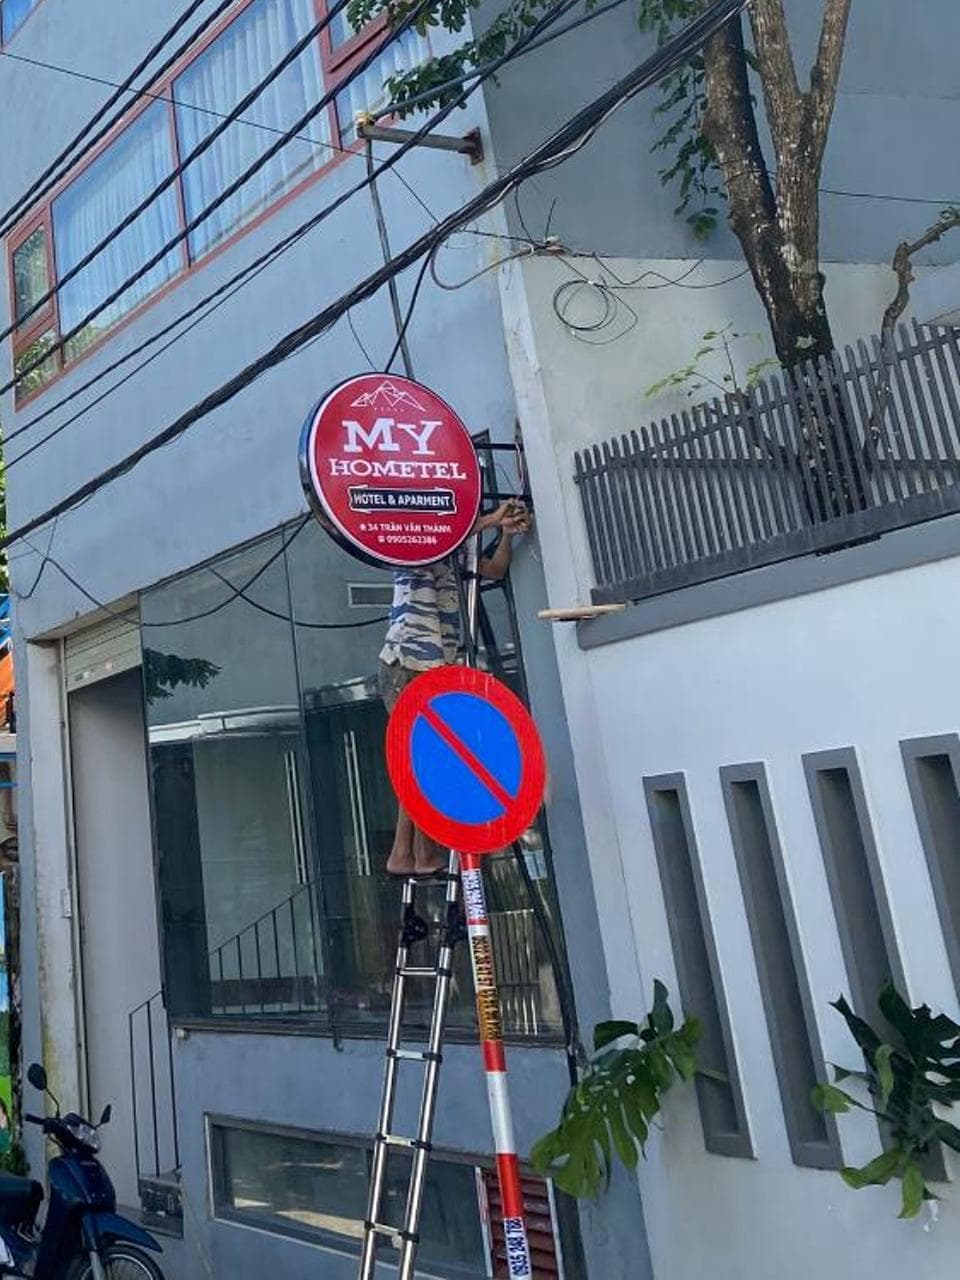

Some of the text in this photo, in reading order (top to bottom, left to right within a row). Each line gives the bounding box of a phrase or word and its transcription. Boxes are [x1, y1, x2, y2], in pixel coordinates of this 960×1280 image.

[341, 417, 444, 456] MY
[328, 458, 467, 480] HOMETEL
[353, 493, 387, 505] HOTEL
[388, 495, 397, 506] &
